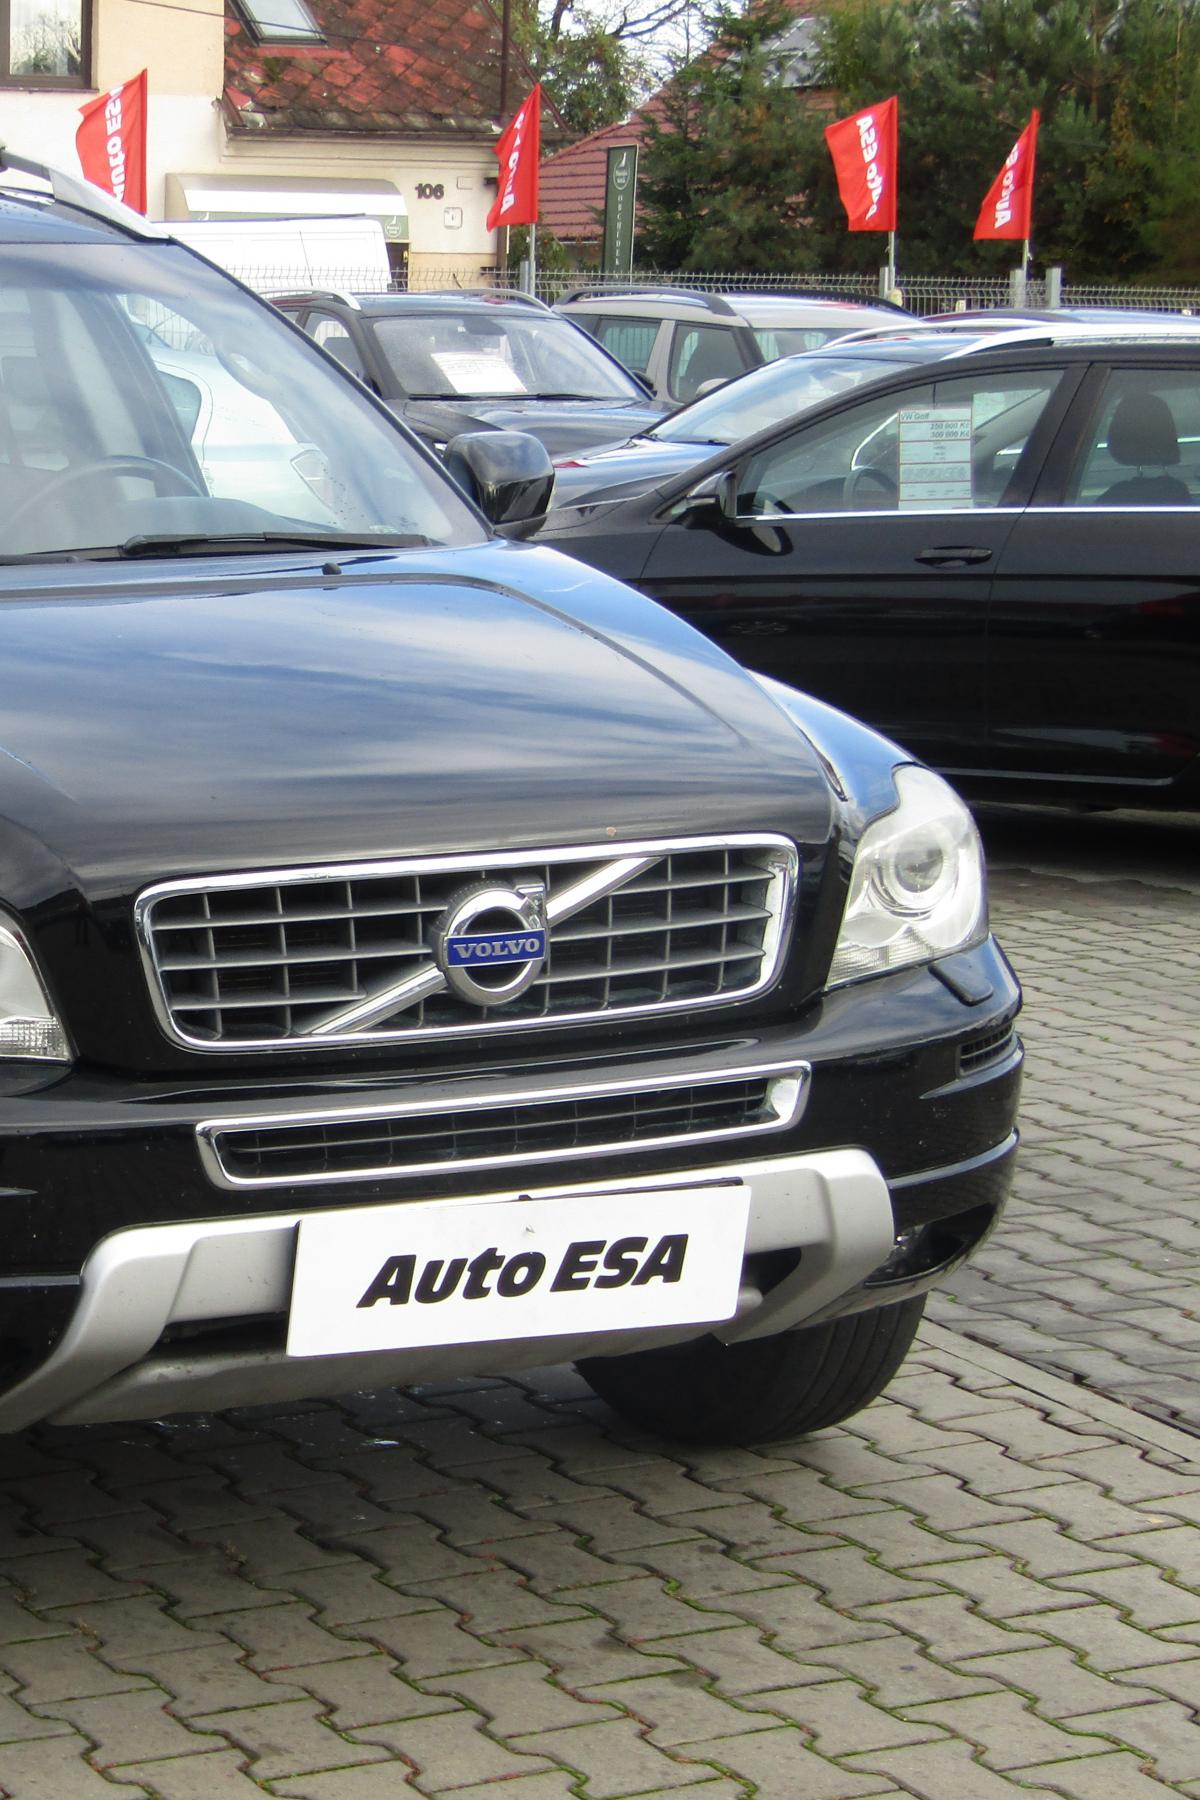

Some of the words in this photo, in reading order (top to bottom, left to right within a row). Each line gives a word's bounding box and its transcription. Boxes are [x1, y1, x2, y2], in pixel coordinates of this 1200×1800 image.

[414, 183, 444, 200] 106
[453, 938, 540, 958] VOLVO
[356, 1247, 546, 1308] Auto
[550, 1234, 689, 1292] ESA
